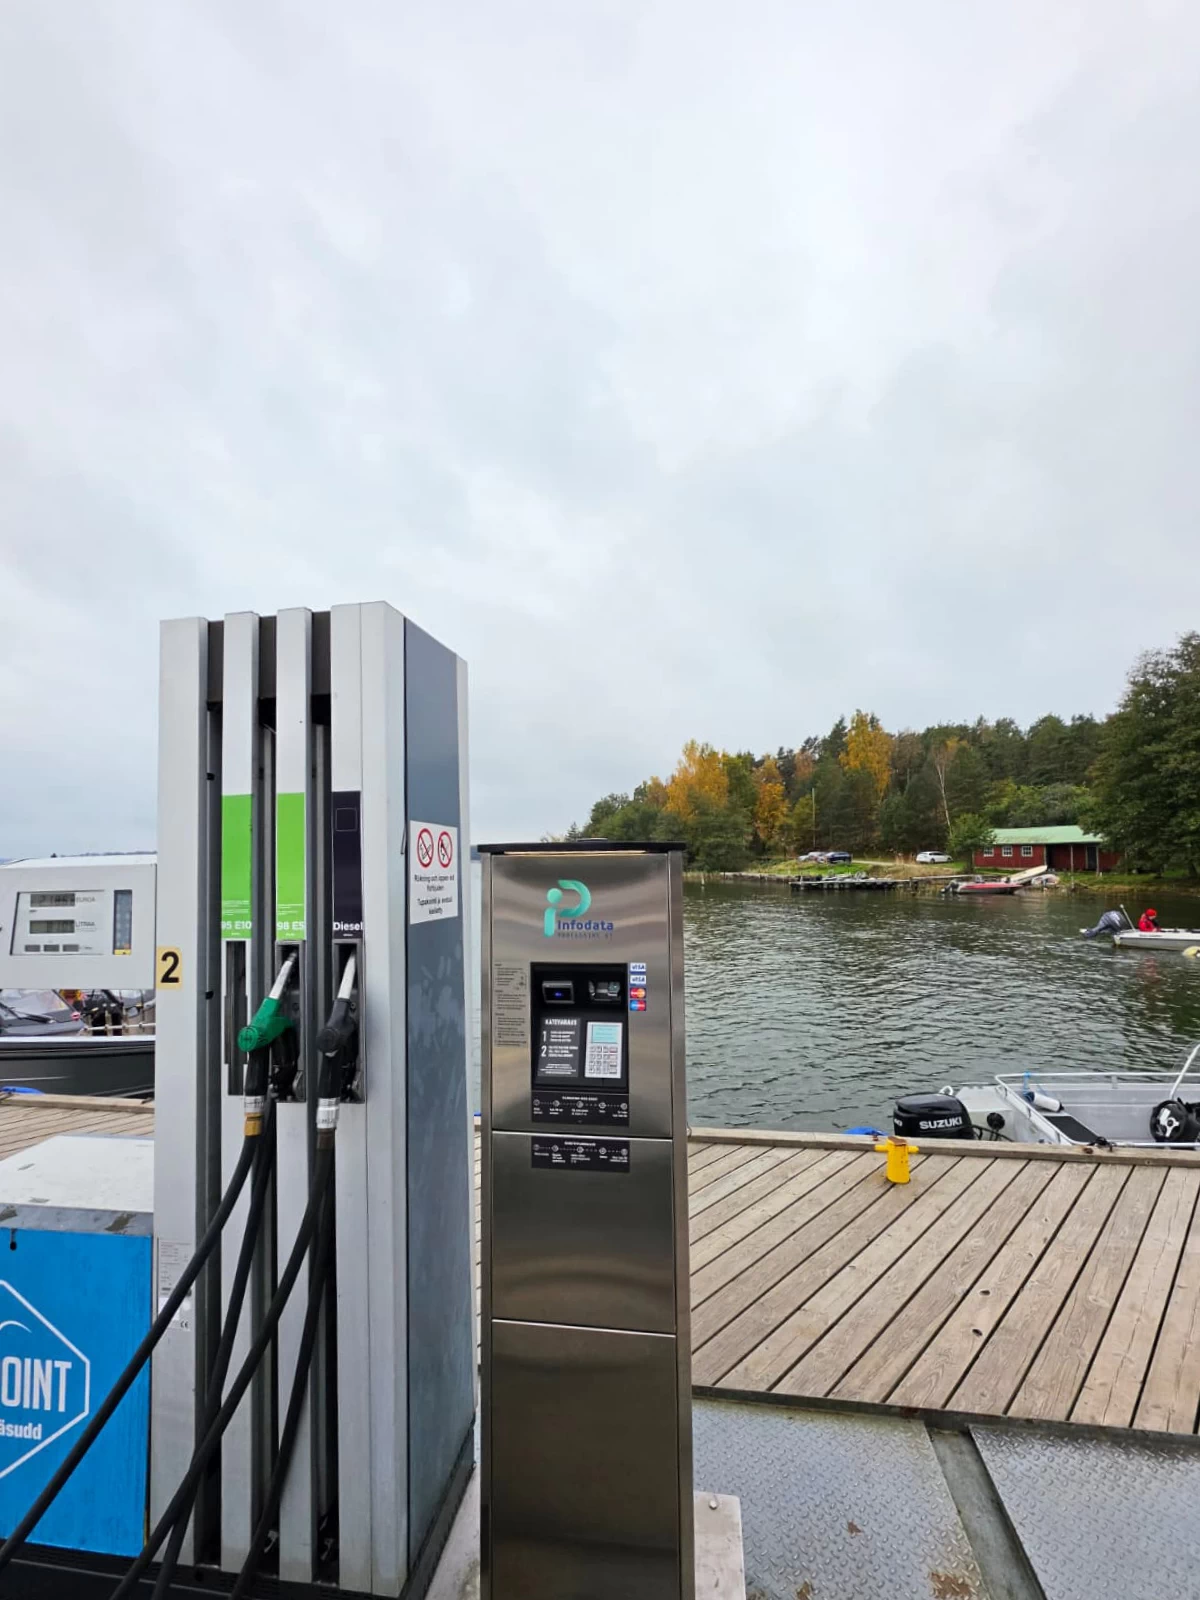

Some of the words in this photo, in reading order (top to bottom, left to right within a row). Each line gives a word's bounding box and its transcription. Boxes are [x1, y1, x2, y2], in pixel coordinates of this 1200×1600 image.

[235, 921, 252, 930] E10
[276, 921, 289, 931] 98
[292, 921, 304, 931] E5
[333, 921, 363, 931] Diesel
[557, 920, 614, 931] Infodata
[160, 951, 180, 983] 2
[542, 1031, 547, 1042] 1
[541, 1045, 547, 1057] 2
[919, 1117, 963, 1130] SUZUKI
[1, 1356, 72, 1413] OINT
